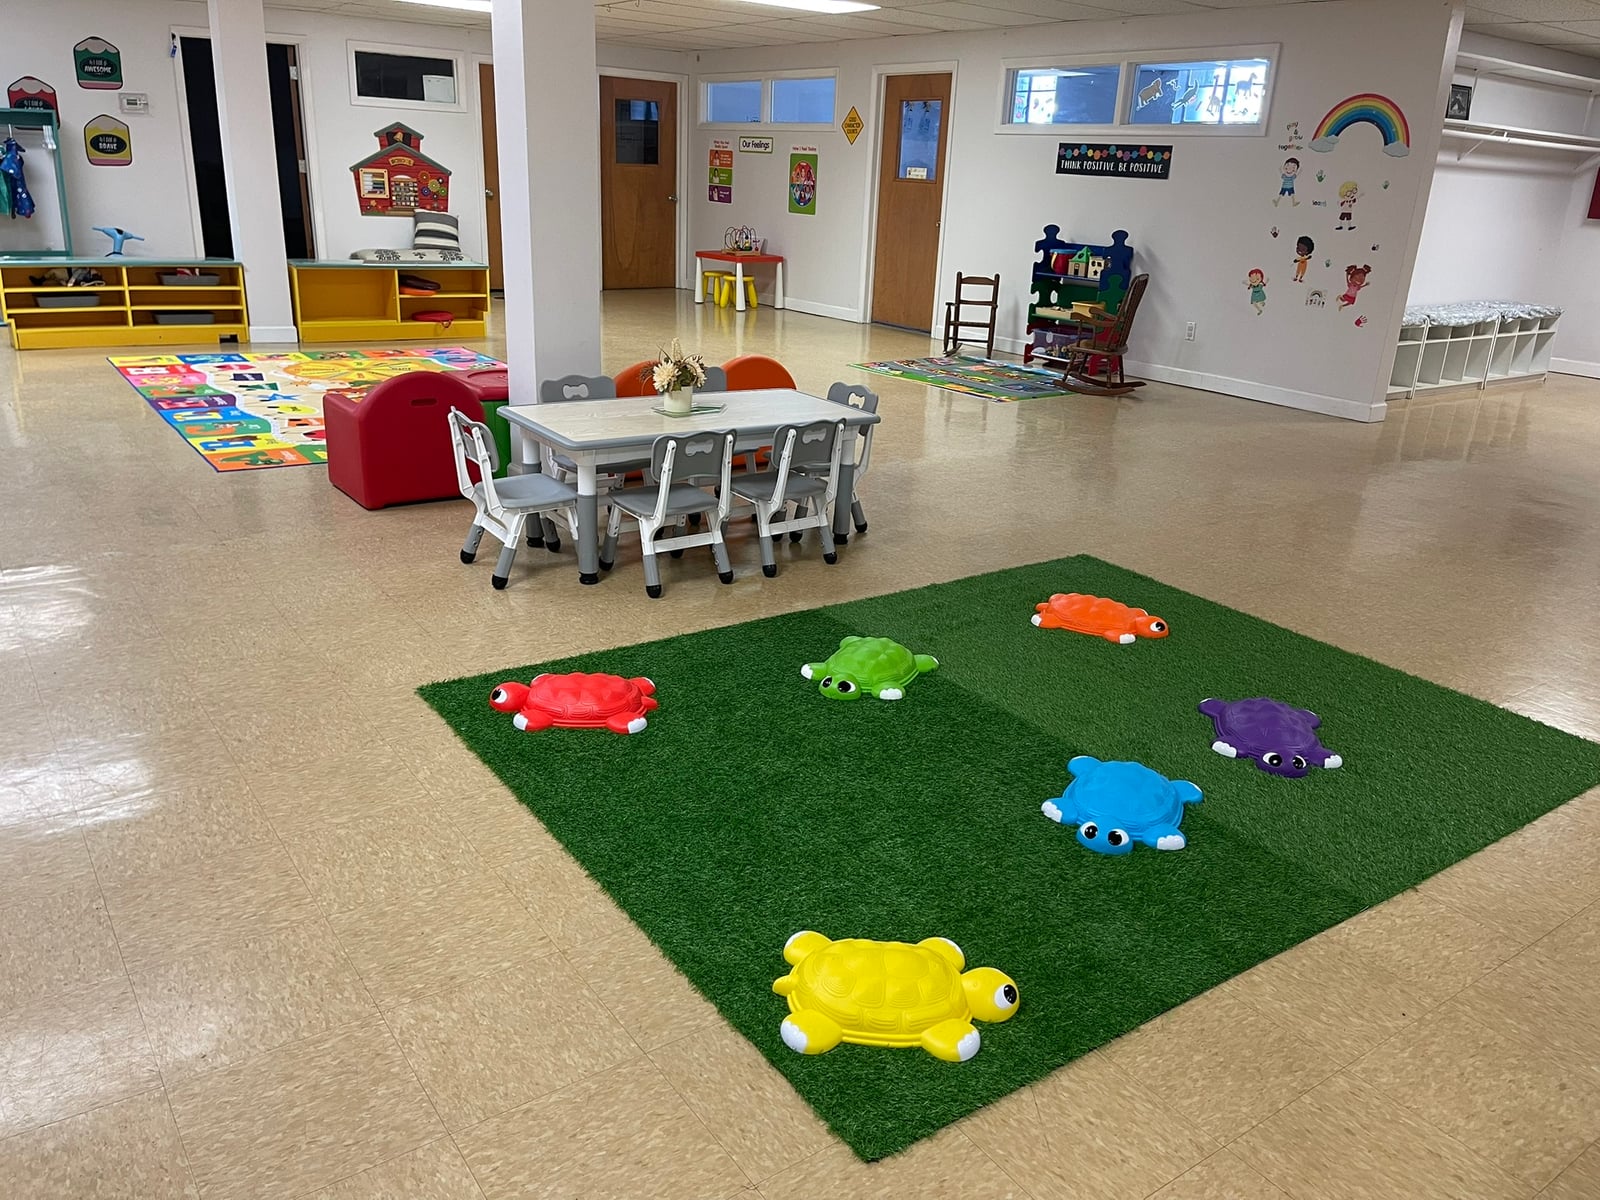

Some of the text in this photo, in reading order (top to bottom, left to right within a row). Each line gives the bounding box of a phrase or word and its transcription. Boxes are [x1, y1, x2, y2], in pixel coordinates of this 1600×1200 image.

[84, 65, 112, 73] AWESOME
[98, 142, 118, 150] BRAVE
[741, 140, 770, 150] Our Feelings
[1060, 159, 1082, 169] THINK
[1118, 162, 1128, 172] BE
